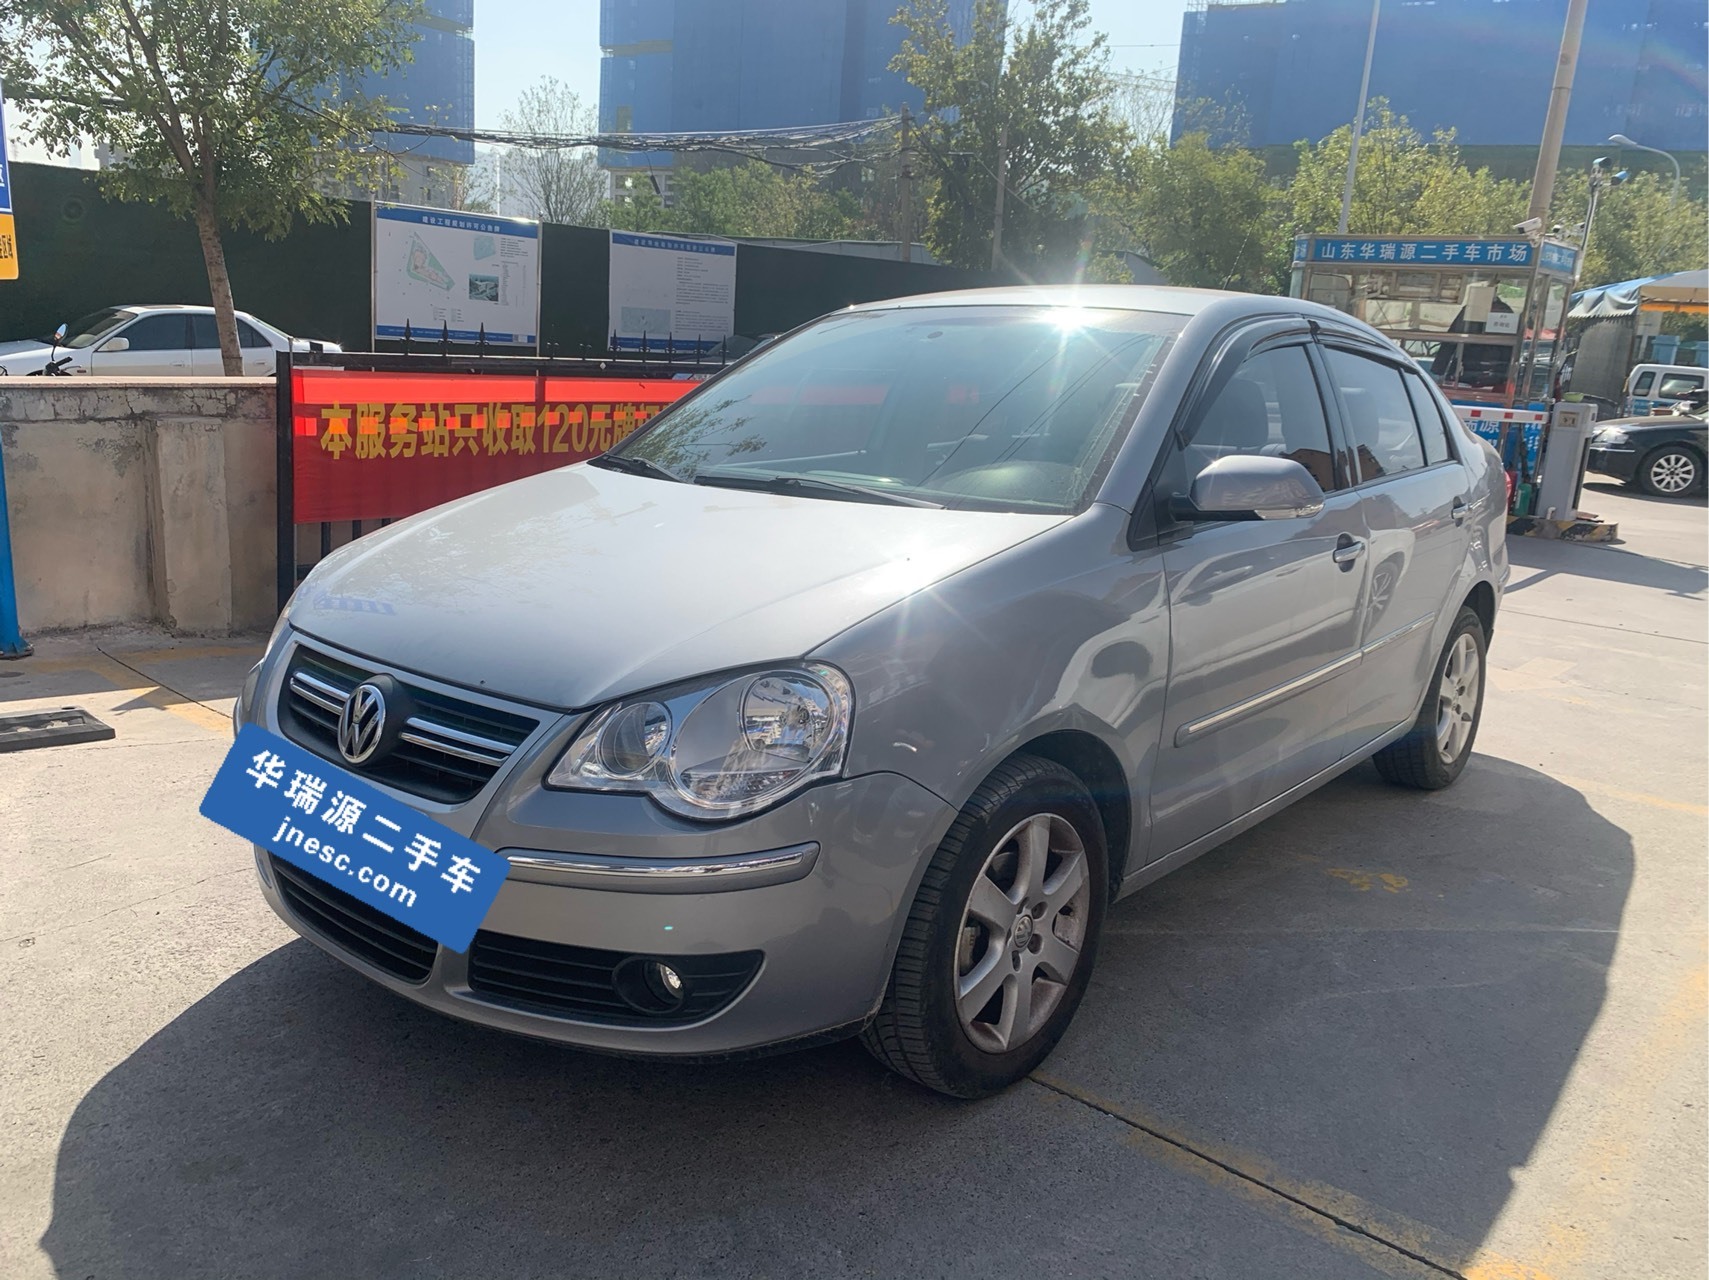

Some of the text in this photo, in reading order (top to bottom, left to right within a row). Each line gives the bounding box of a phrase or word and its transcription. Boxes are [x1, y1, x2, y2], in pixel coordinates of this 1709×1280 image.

[1321, 242, 1528, 262] 山东华瑞源二手车市场
